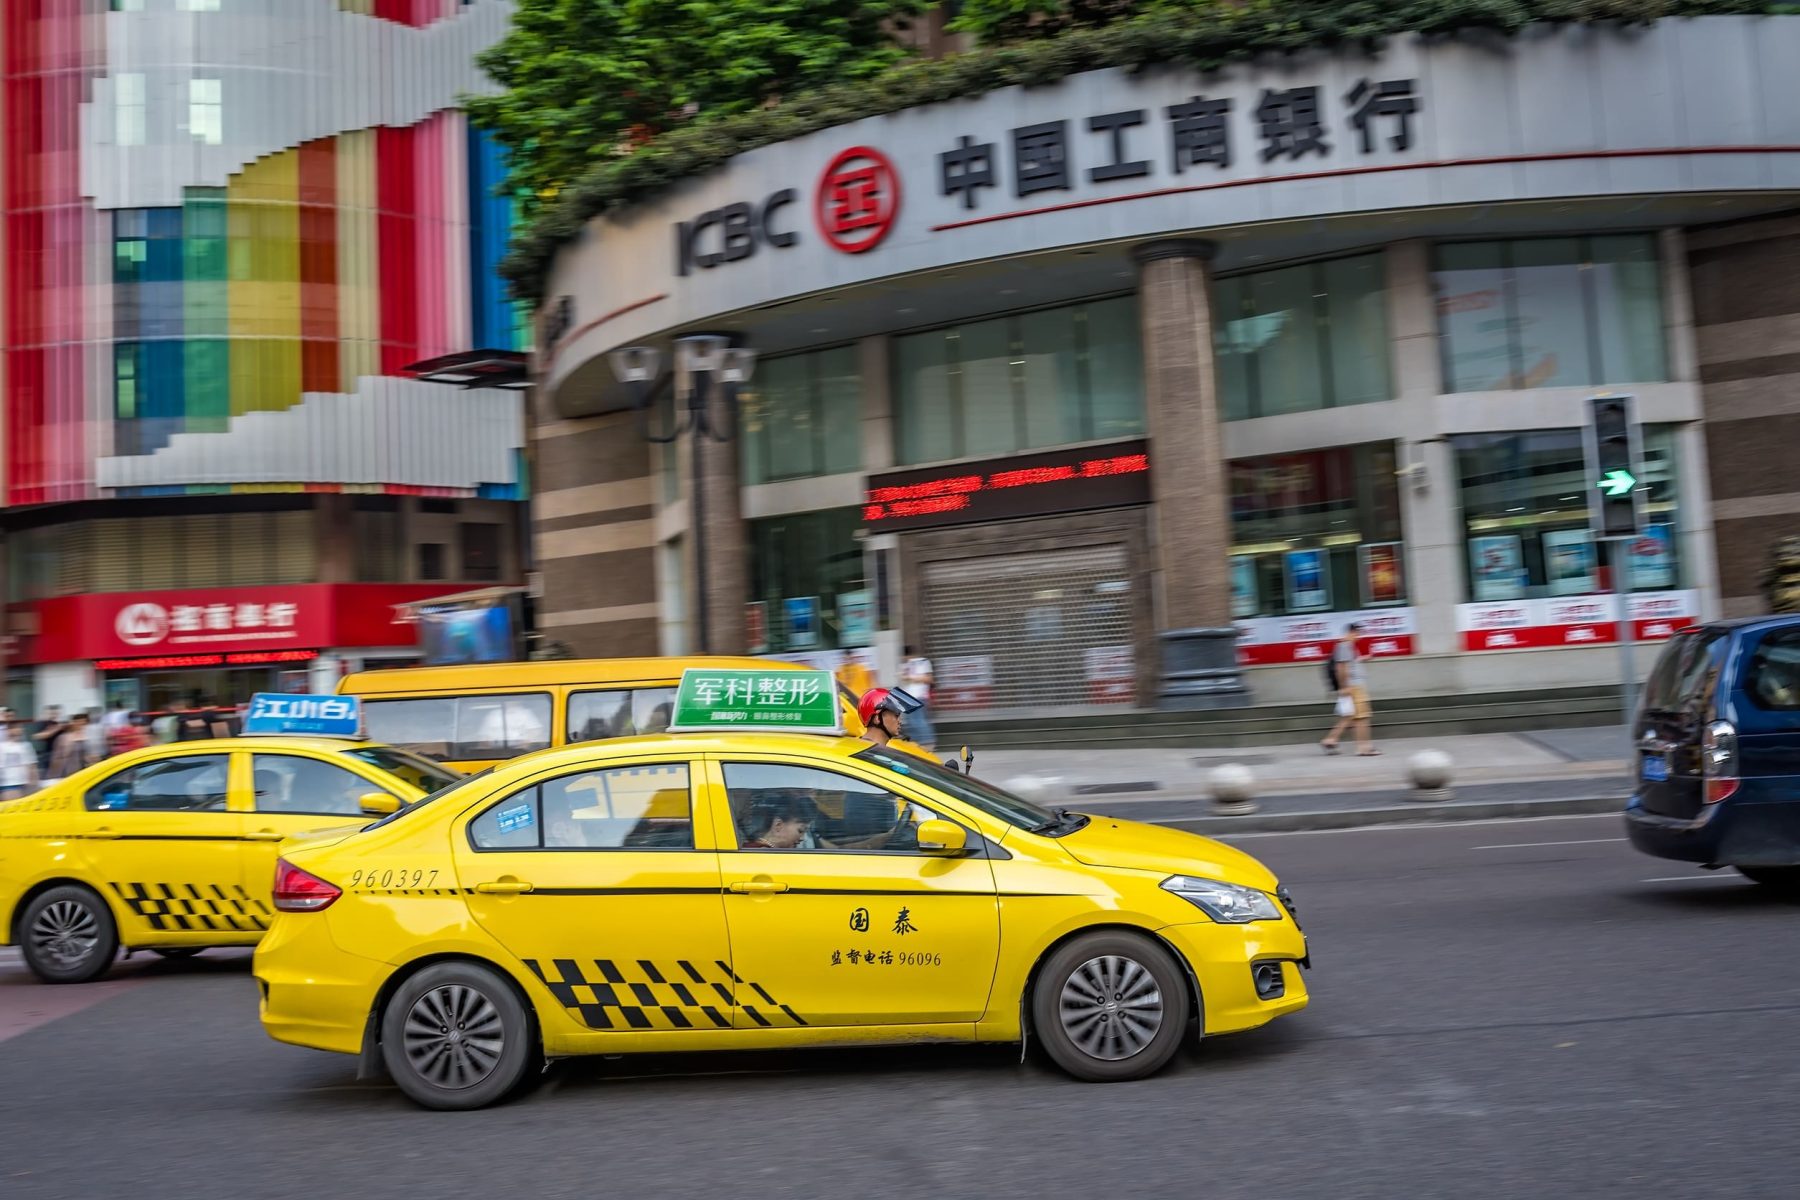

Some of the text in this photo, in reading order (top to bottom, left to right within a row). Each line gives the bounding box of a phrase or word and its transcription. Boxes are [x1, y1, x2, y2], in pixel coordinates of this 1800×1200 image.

[674, 188, 799, 276] ICBC
[692, 678, 820, 706] 军科整形
[350, 869, 439, 888] 960397
